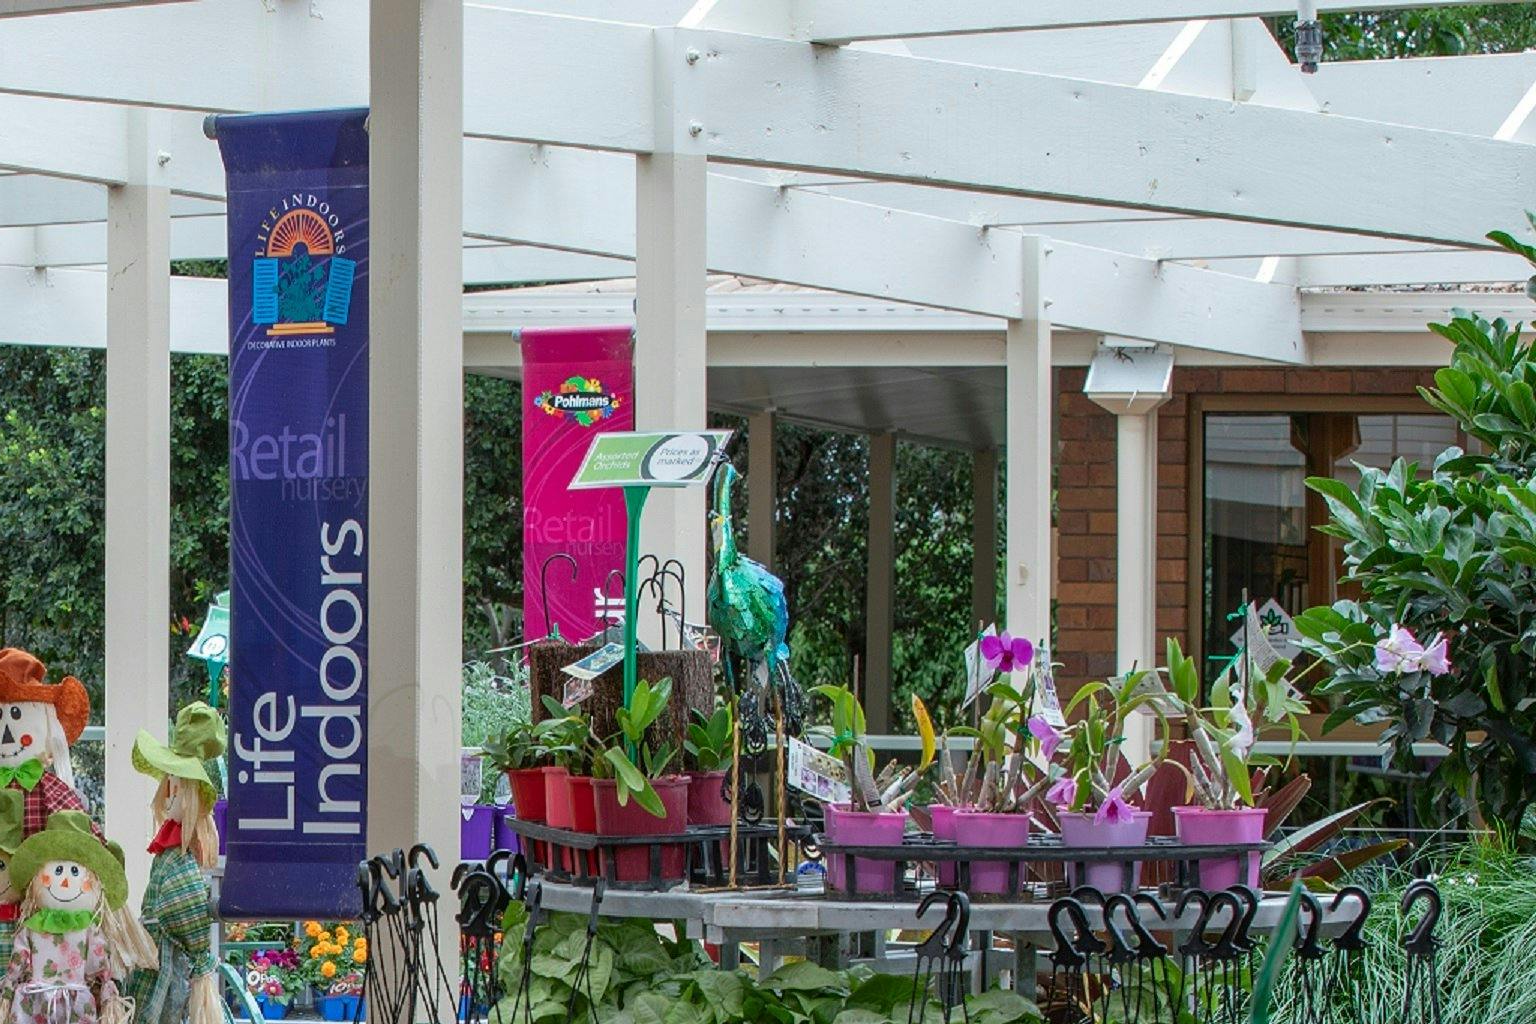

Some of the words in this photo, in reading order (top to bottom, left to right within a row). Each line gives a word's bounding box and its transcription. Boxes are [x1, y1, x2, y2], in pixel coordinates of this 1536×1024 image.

[254, 206, 280, 258] LIFE
[281, 193, 347, 255] INDOORS
[554, 394, 610, 409] Pohlmans
[230, 413, 346, 481] Retail
[281, 477, 367, 509] nursery
[524, 504, 612, 543] Retail
[300, 518, 364, 835] Indoors
[233, 691, 296, 831] Life
